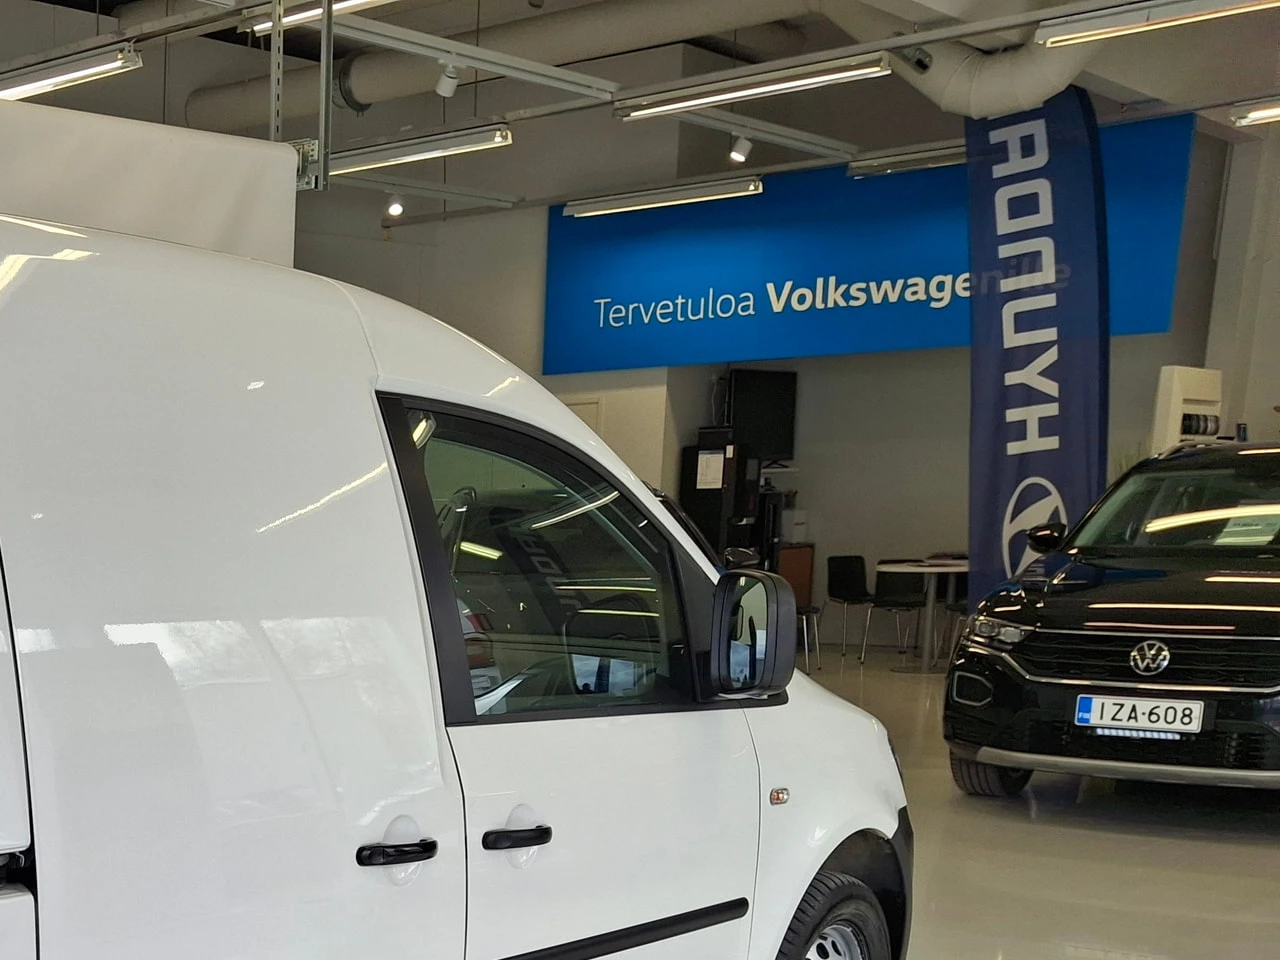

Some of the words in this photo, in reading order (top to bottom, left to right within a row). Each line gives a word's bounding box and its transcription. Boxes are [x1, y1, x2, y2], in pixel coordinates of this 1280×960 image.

[987, 117, 1060, 456] HYUNDA
[593, 287, 756, 328] Tervetuloa
[1099, 702, 1193, 726] IZA-608
